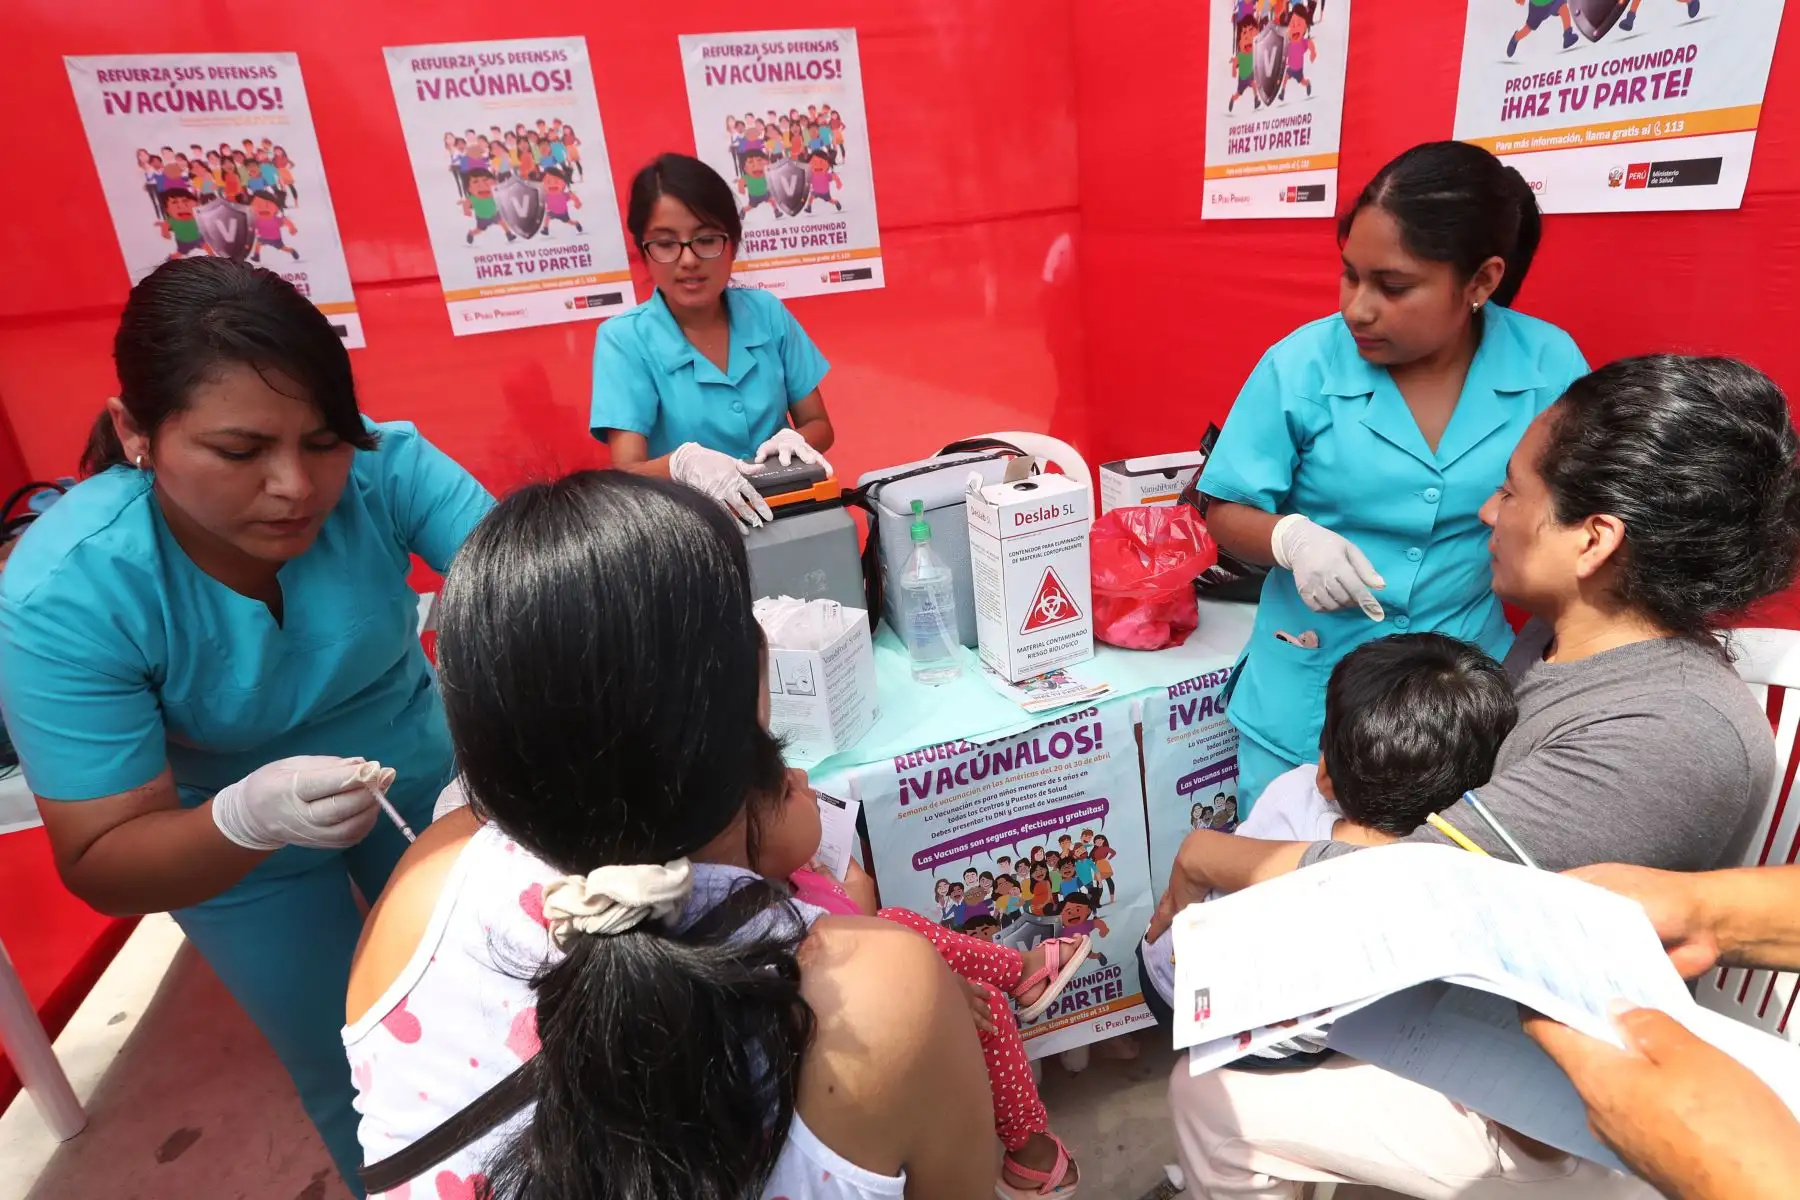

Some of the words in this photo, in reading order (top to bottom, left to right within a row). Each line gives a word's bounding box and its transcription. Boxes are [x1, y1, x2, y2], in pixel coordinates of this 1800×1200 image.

[411, 55, 475, 72] REFUERZA
[478, 52, 505, 67] SUS
[507, 49, 568, 64] DEFENSAS
[702, 43, 759, 58] REFUERZA
[761, 42, 785, 55] SUS
[787, 40, 840, 54] DEFENSAS
[97, 67, 171, 84] REFUERZA
[174, 66, 204, 81] SUS
[208, 65, 278, 81] DEFENSAS
[705, 55, 842, 86] ¡VACÚNALOS!
[1505, 69, 1563, 94] PROTEGE
[1565, 67, 1575, 83] A
[1580, 63, 1598, 80] TU
[1601, 44, 1698, 77] COMUNIDAD
[416, 68, 573, 101] ¡VACÚNALOS!
[1500, 91, 1552, 121] ¡HAZ
[1558, 85, 1590, 113] TU
[1593, 67, 1694, 110] PARTE!
[102, 81, 284, 115] ¡VACÚNALOS!
[1262, 119, 1271, 130] TU
[1271, 112, 1312, 129] COMUNIDAD
[1228, 136, 1251, 155] ¡HAZ
[1253, 134, 1267, 152] TU
[1269, 127, 1311, 150] PARTE!
[1513, 137, 1530, 149] más
[1530, 130, 1583, 147] información,
[1585, 128, 1610, 141] llama
[1612, 124, 1639, 141] gratis
[1642, 121, 1651, 135] al
[1664, 120, 1685, 133] 113
[1628, 170, 1648, 181] PERÚ
[1652, 169, 1680, 178] Ministerio
[1659, 176, 1674, 184] Salud
[782, 226, 788, 234] A
[790, 224, 800, 233] TU
[800, 221, 847, 233] COMUNIDAD
[516, 251, 524, 259] A
[525, 249, 537, 258] TU
[538, 243, 590, 257] COMUNIDAD
[745, 238, 778, 253] ¡HAZ
[782, 236, 798, 249] TU
[801, 231, 848, 248] PARTE!
[476, 263, 513, 279] ¡HAZ
[516, 261, 535, 275] TU
[539, 254, 592, 273] PARTE!
[1014, 504, 1060, 527] Deslab
[1062, 503, 1076, 516] 5L
[1041, 542, 1055, 550] PARA
[1016, 642, 1046, 654] MATERIAL
[1045, 628, 1088, 646] CONTAMINADO
[1027, 649, 1049, 660] RIESGO
[1168, 667, 1234, 700] REFUERZ
[899, 721, 1103, 806] ¡VACÚNALOS!
[897, 804, 928, 820] Semana
[929, 801, 938, 810] de
[939, 785, 981, 806] vacunación
[991, 779, 1004, 788] las
[1005, 770, 1040, 784] Américas
[1040, 765, 1052, 776] del
[1053, 763, 1063, 772] 20
[1064, 760, 1073, 770] al
[1073, 757, 1083, 767] 30
[1084, 755, 1093, 764] de
[1093, 751, 1111, 763] abril
[1180, 781, 1193, 790] Las
[1193, 769, 1221, 785] Vacunas
[1221, 765, 1233, 775] son
[924, 814, 933, 822] La
[934, 800, 973, 821] Vacunación
[973, 798, 982, 806] es
[982, 792, 998, 806] para
[998, 785, 1018, 799] niños
[1017, 779, 1047, 793] menores
[1047, 775, 1056, 785] de
[1062, 771, 1079, 781] años
[1079, 769, 1089, 777] en
[947, 812, 967, 824] todos
[967, 807, 978, 817] los
[979, 799, 1005, 813] Centros
[1010, 791, 1038, 805] Puestos
[1038, 788, 1047, 797] de
[1047, 783, 1068, 795] Salud
[931, 828, 952, 839] Debes
[952, 816, 985, 833] presentar
[985, 813, 994, 822] tu
[993, 808, 1007, 819] DNI
[1012, 800, 1036, 813] Carnet
[1036, 797, 1046, 806] de
[918, 854, 933, 866] Las
[933, 842, 970, 860] Vacunas
[969, 838, 985, 848] son
[985, 827, 1020, 844] seguras,
[1020, 817, 1058, 834] efectivas
[1058, 814, 1065, 824] y
[1064, 802, 1105, 823] gratuitas!
[1062, 965, 1123, 994] MUNIDAD
[1046, 979, 1124, 1020] PARTE!
[1069, 1011, 1090, 1025] gratis
[1095, 1023, 1105, 1032] EL
[1105, 1018, 1125, 1029] PERÚ
